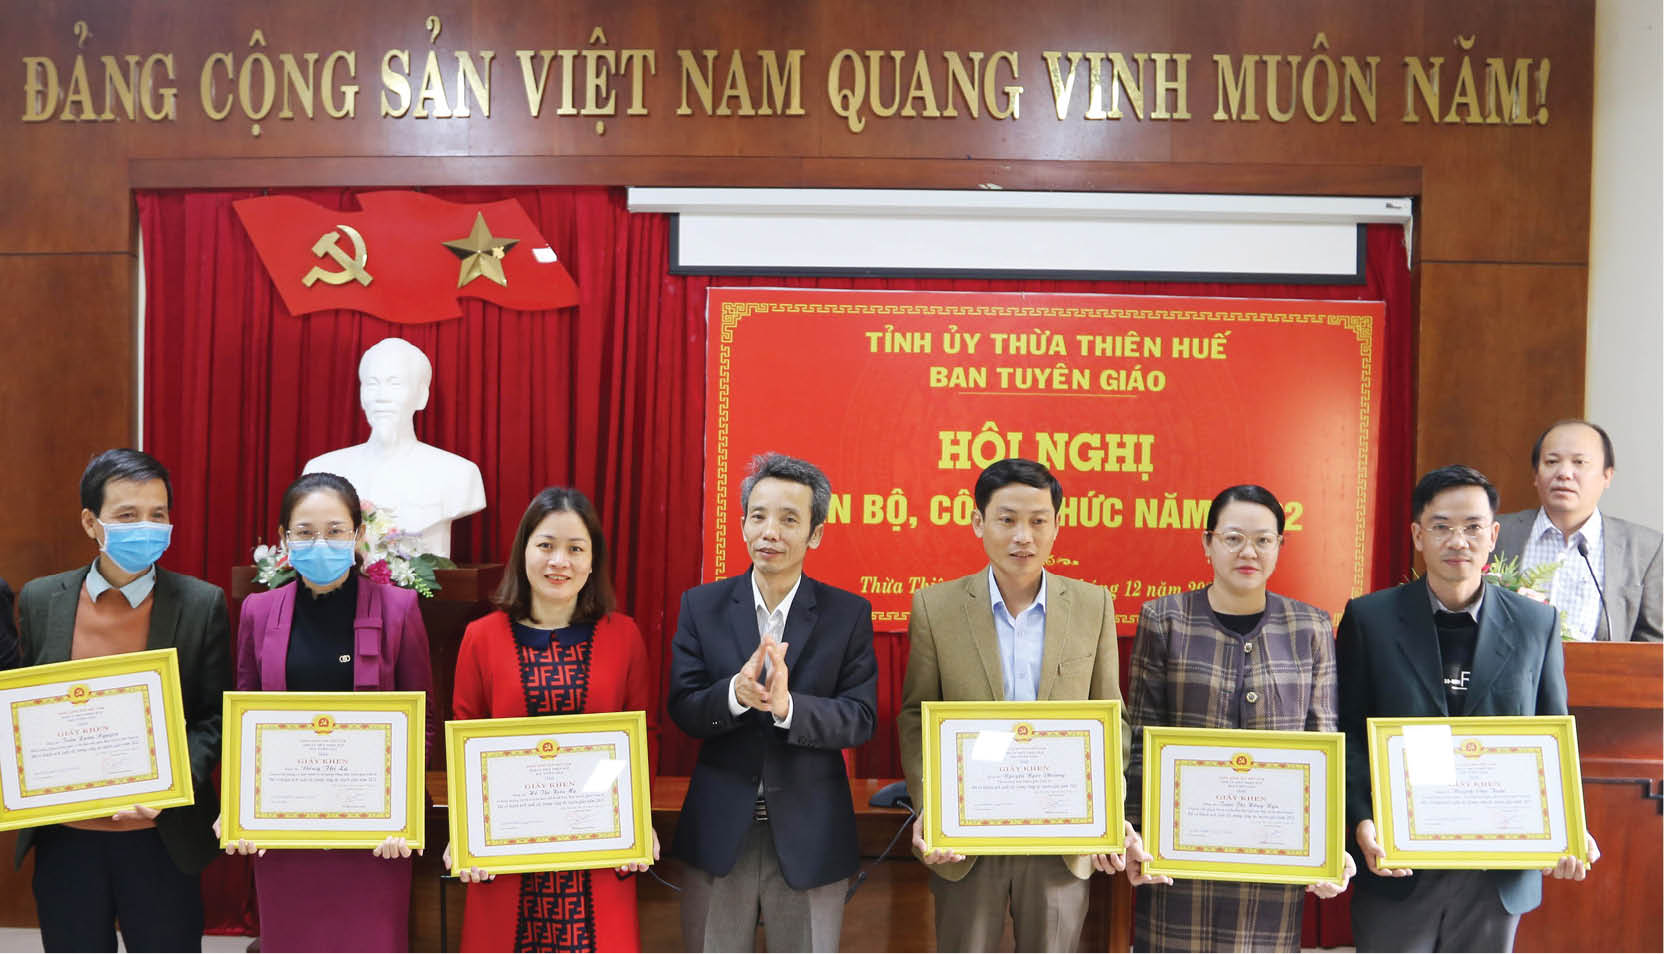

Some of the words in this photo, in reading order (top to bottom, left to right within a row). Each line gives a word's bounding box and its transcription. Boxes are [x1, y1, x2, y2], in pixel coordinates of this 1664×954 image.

[22, 20, 178, 122] ĐẢNG
[200, 28, 359, 136] CỘNG
[380, 15, 496, 119] SẢN
[515, 25, 656, 135] VIỆT
[675, 48, 807, 117] NAM
[827, 48, 1024, 134] QUANG
[1042, 50, 1192, 121] VINH
[1212, 31, 1381, 122] MUÔN
[1401, 33, 1551, 125] NĂM!
[865, 325, 932, 354] TỈNH
[943, 325, 982, 354] ỦY
[990, 329, 1067, 356] THỪA
[1076, 331, 1162, 358] THIÊN
[1172, 330, 1232, 360] HUẾ
[929, 366, 987, 388] BAN
[996, 363, 1091, 390] TUYÊN
[1099, 365, 1167, 392] GIÁO
[1035, 432, 1155, 480] NGHỊ
[863, 488, 918, 531] BỘ,
[1058, 490, 1123, 528] HỨC
[1135, 492, 1212, 529] NĂM
[860, 576, 904, 593] Thừa
[1124, 580, 1142, 597] 12
[1146, 580, 1182, 597] năm
